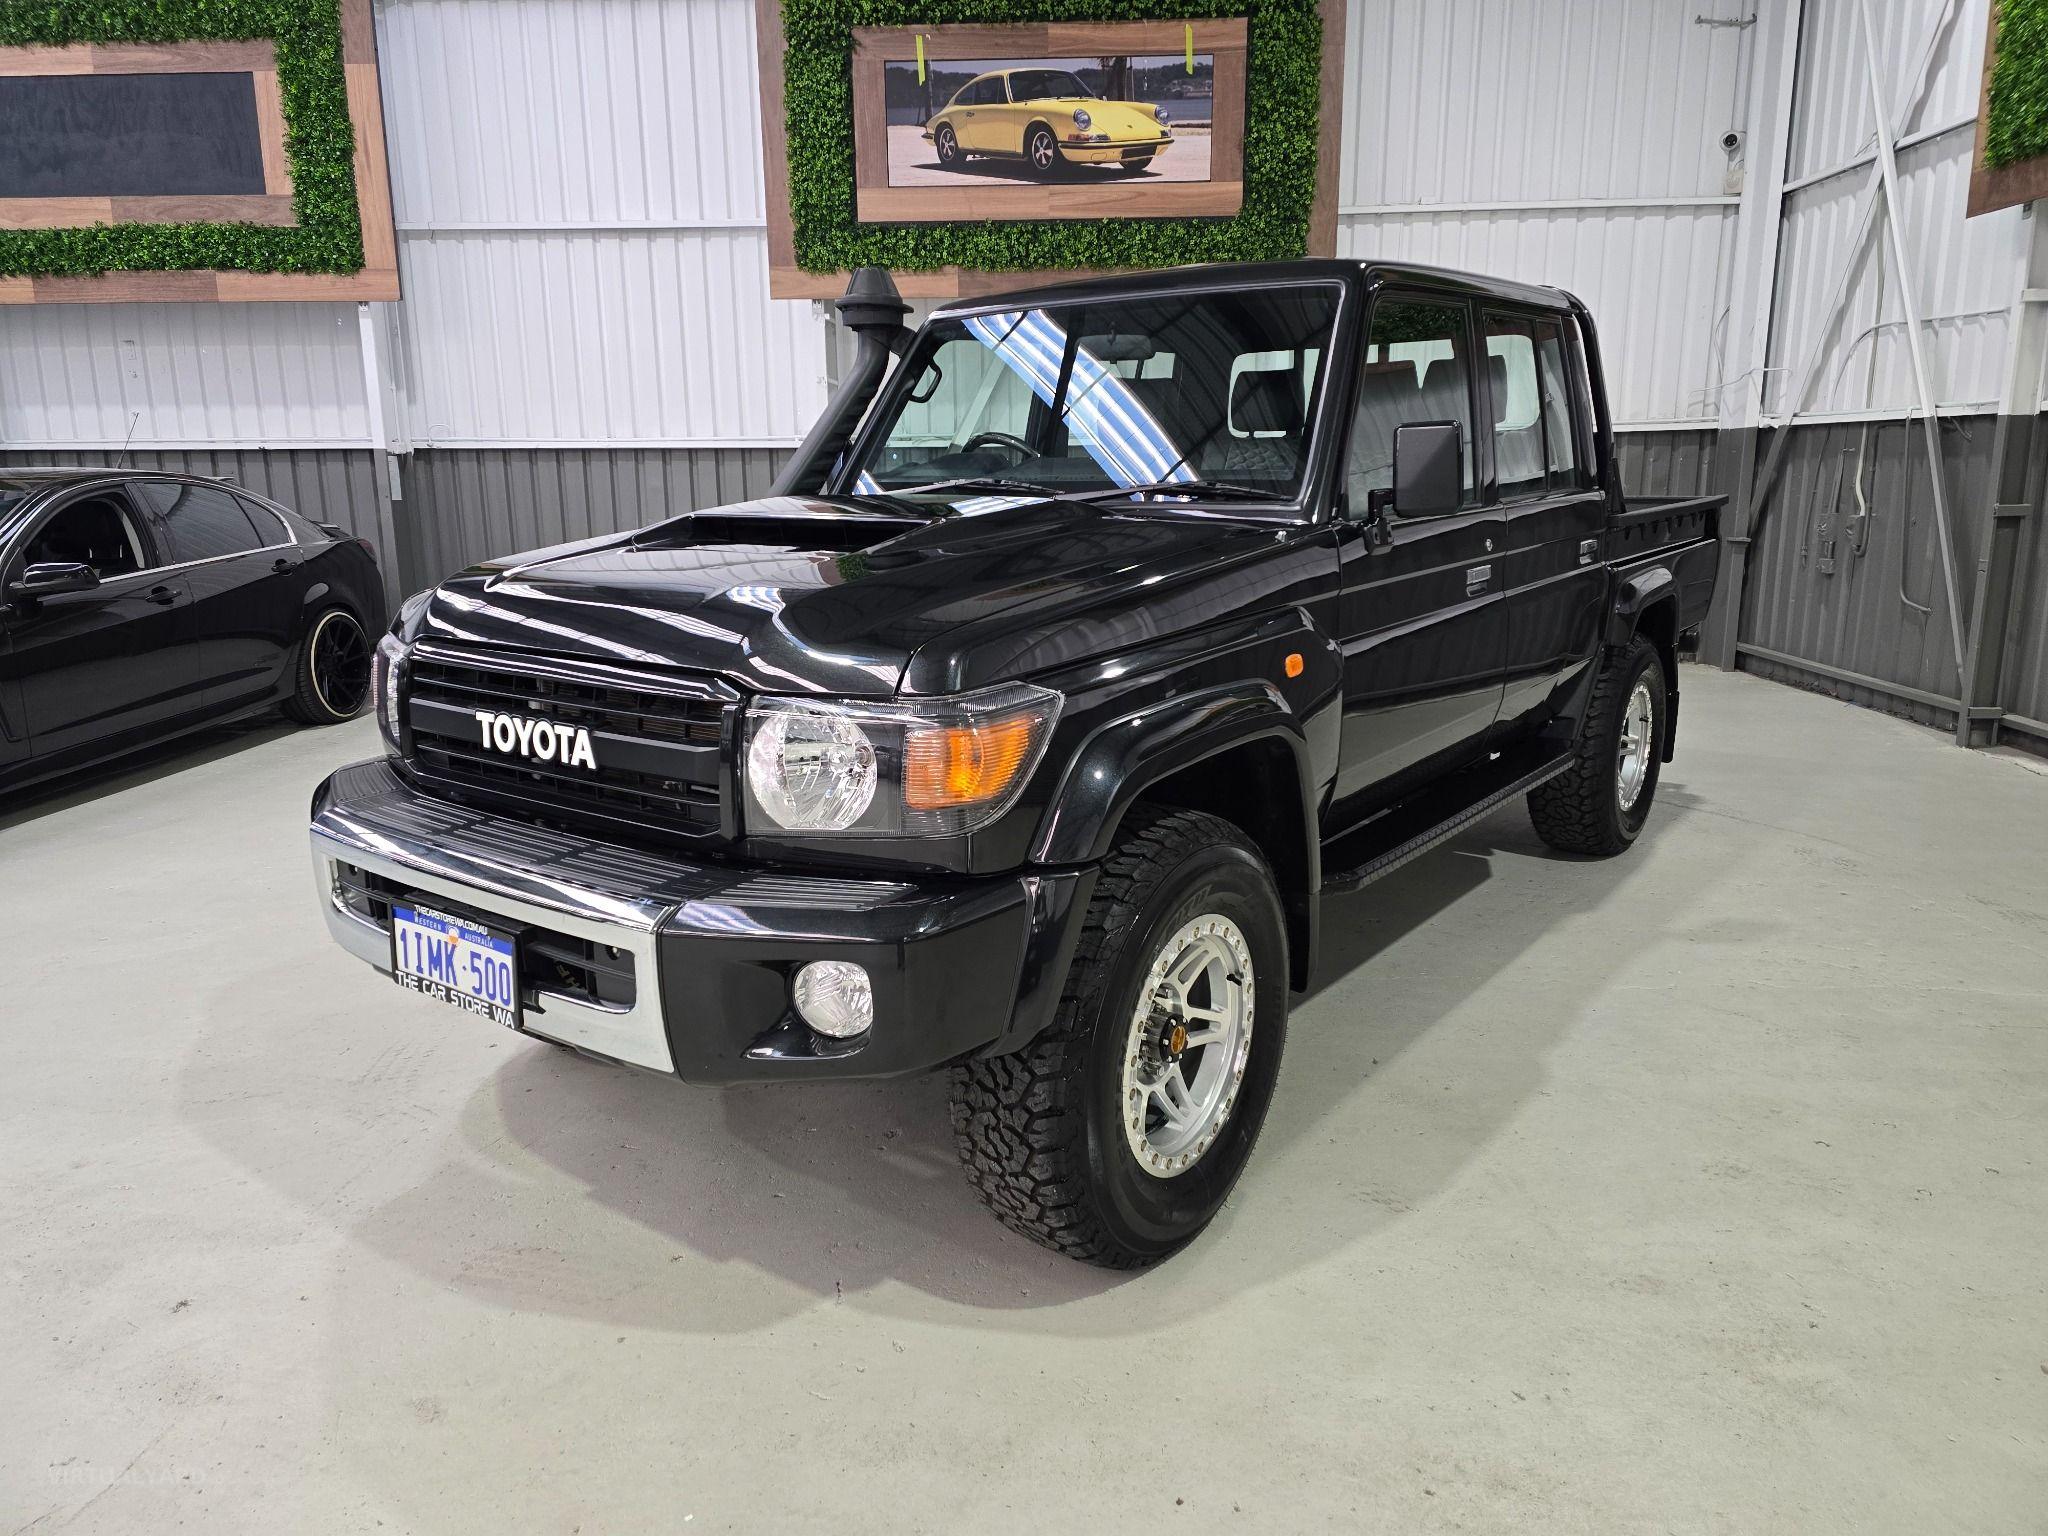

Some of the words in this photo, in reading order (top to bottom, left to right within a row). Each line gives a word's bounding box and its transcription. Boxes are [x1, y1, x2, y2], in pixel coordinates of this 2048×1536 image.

[475, 712, 597, 770] TOYOTA
[395, 970, 419, 992] THE
[422, 980, 447, 1003] CAR
[450, 990, 490, 1018] STORE
[492, 1005, 515, 1030] WA
